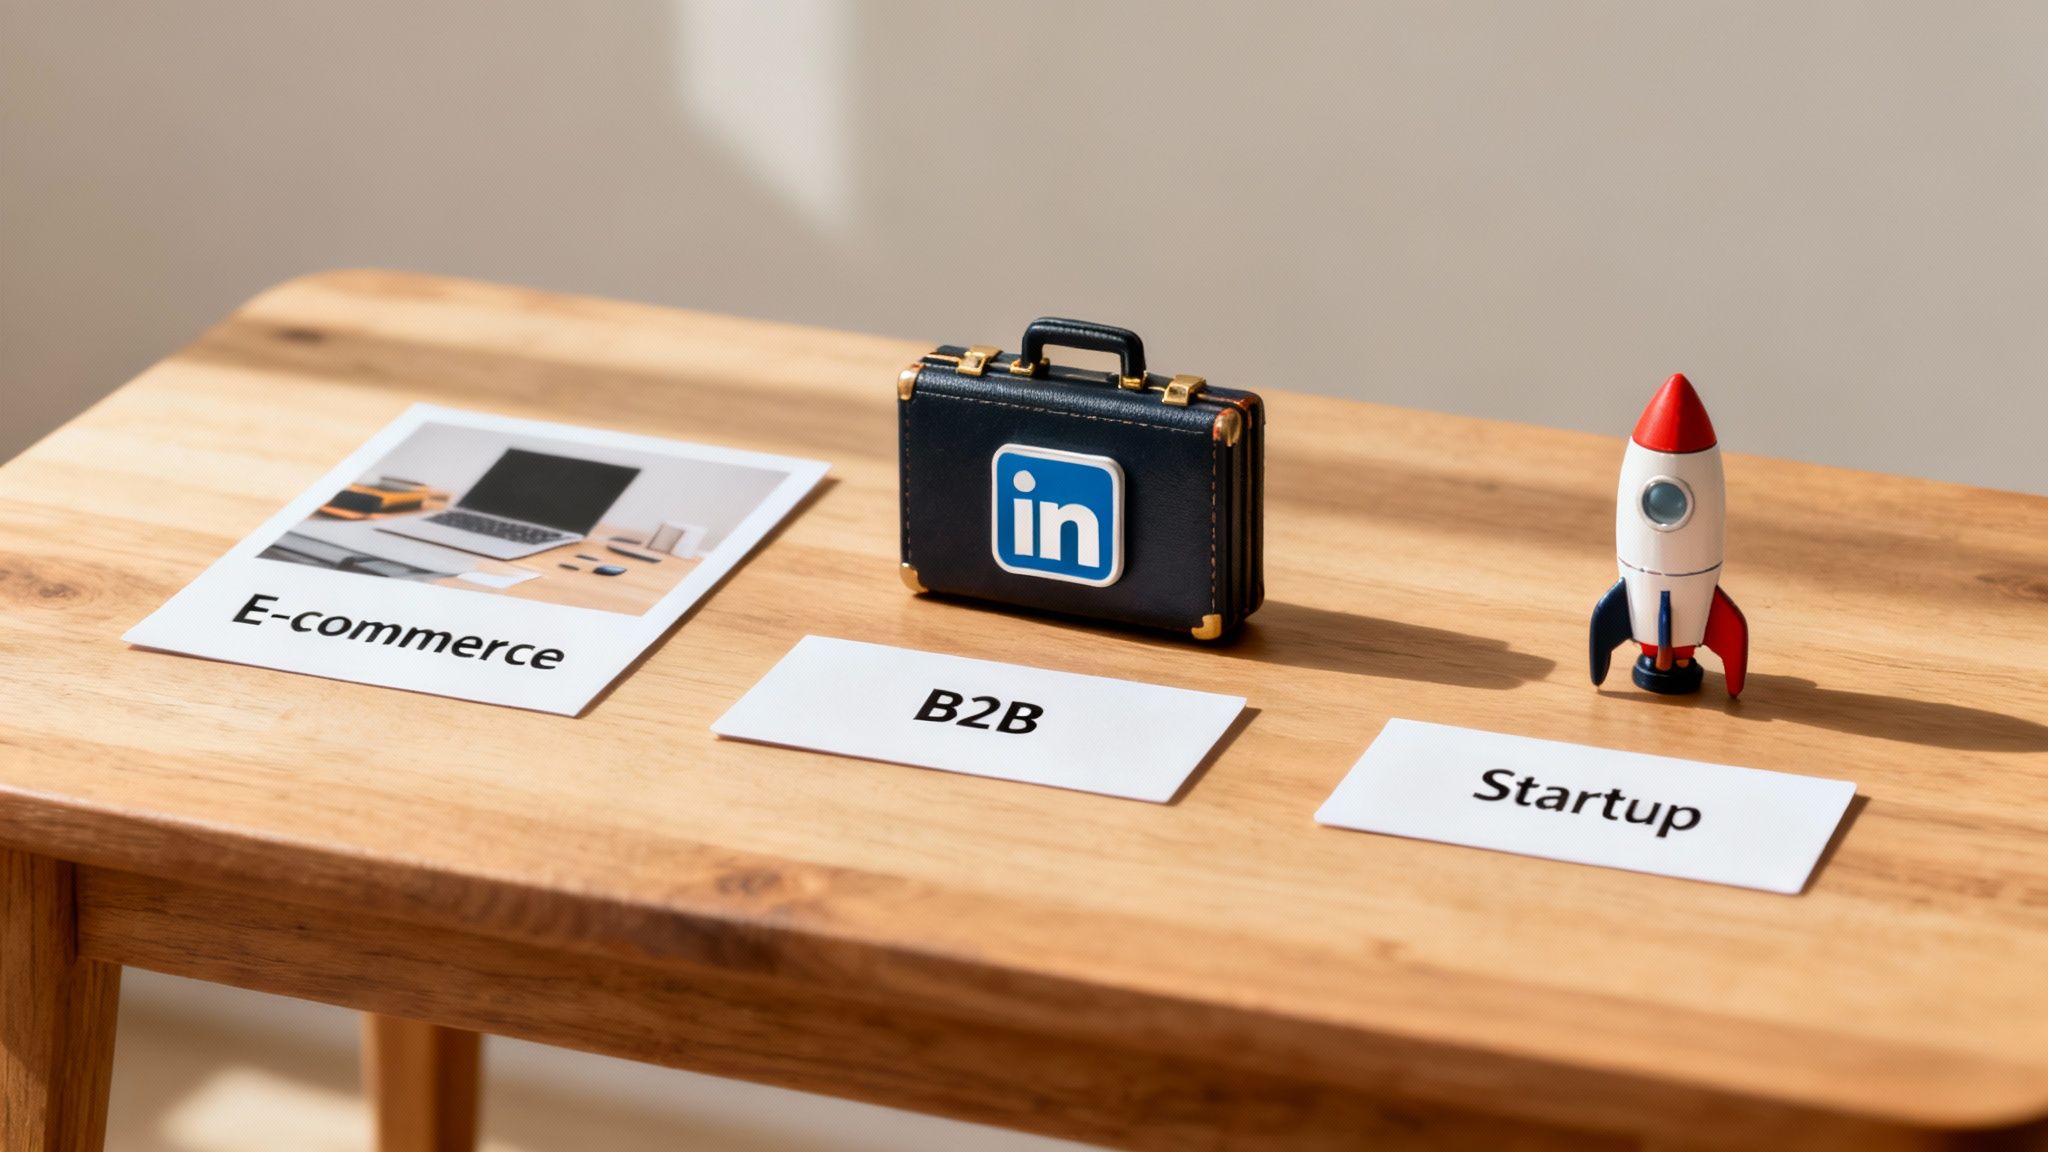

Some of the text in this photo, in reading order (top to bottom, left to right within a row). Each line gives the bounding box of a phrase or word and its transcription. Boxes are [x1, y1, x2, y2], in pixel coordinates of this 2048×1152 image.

[1013, 470, 1100, 568] in
[232, 593, 565, 670] E-commerce
[914, 688, 1044, 735] B2B
[1473, 768, 1702, 838] Startup
